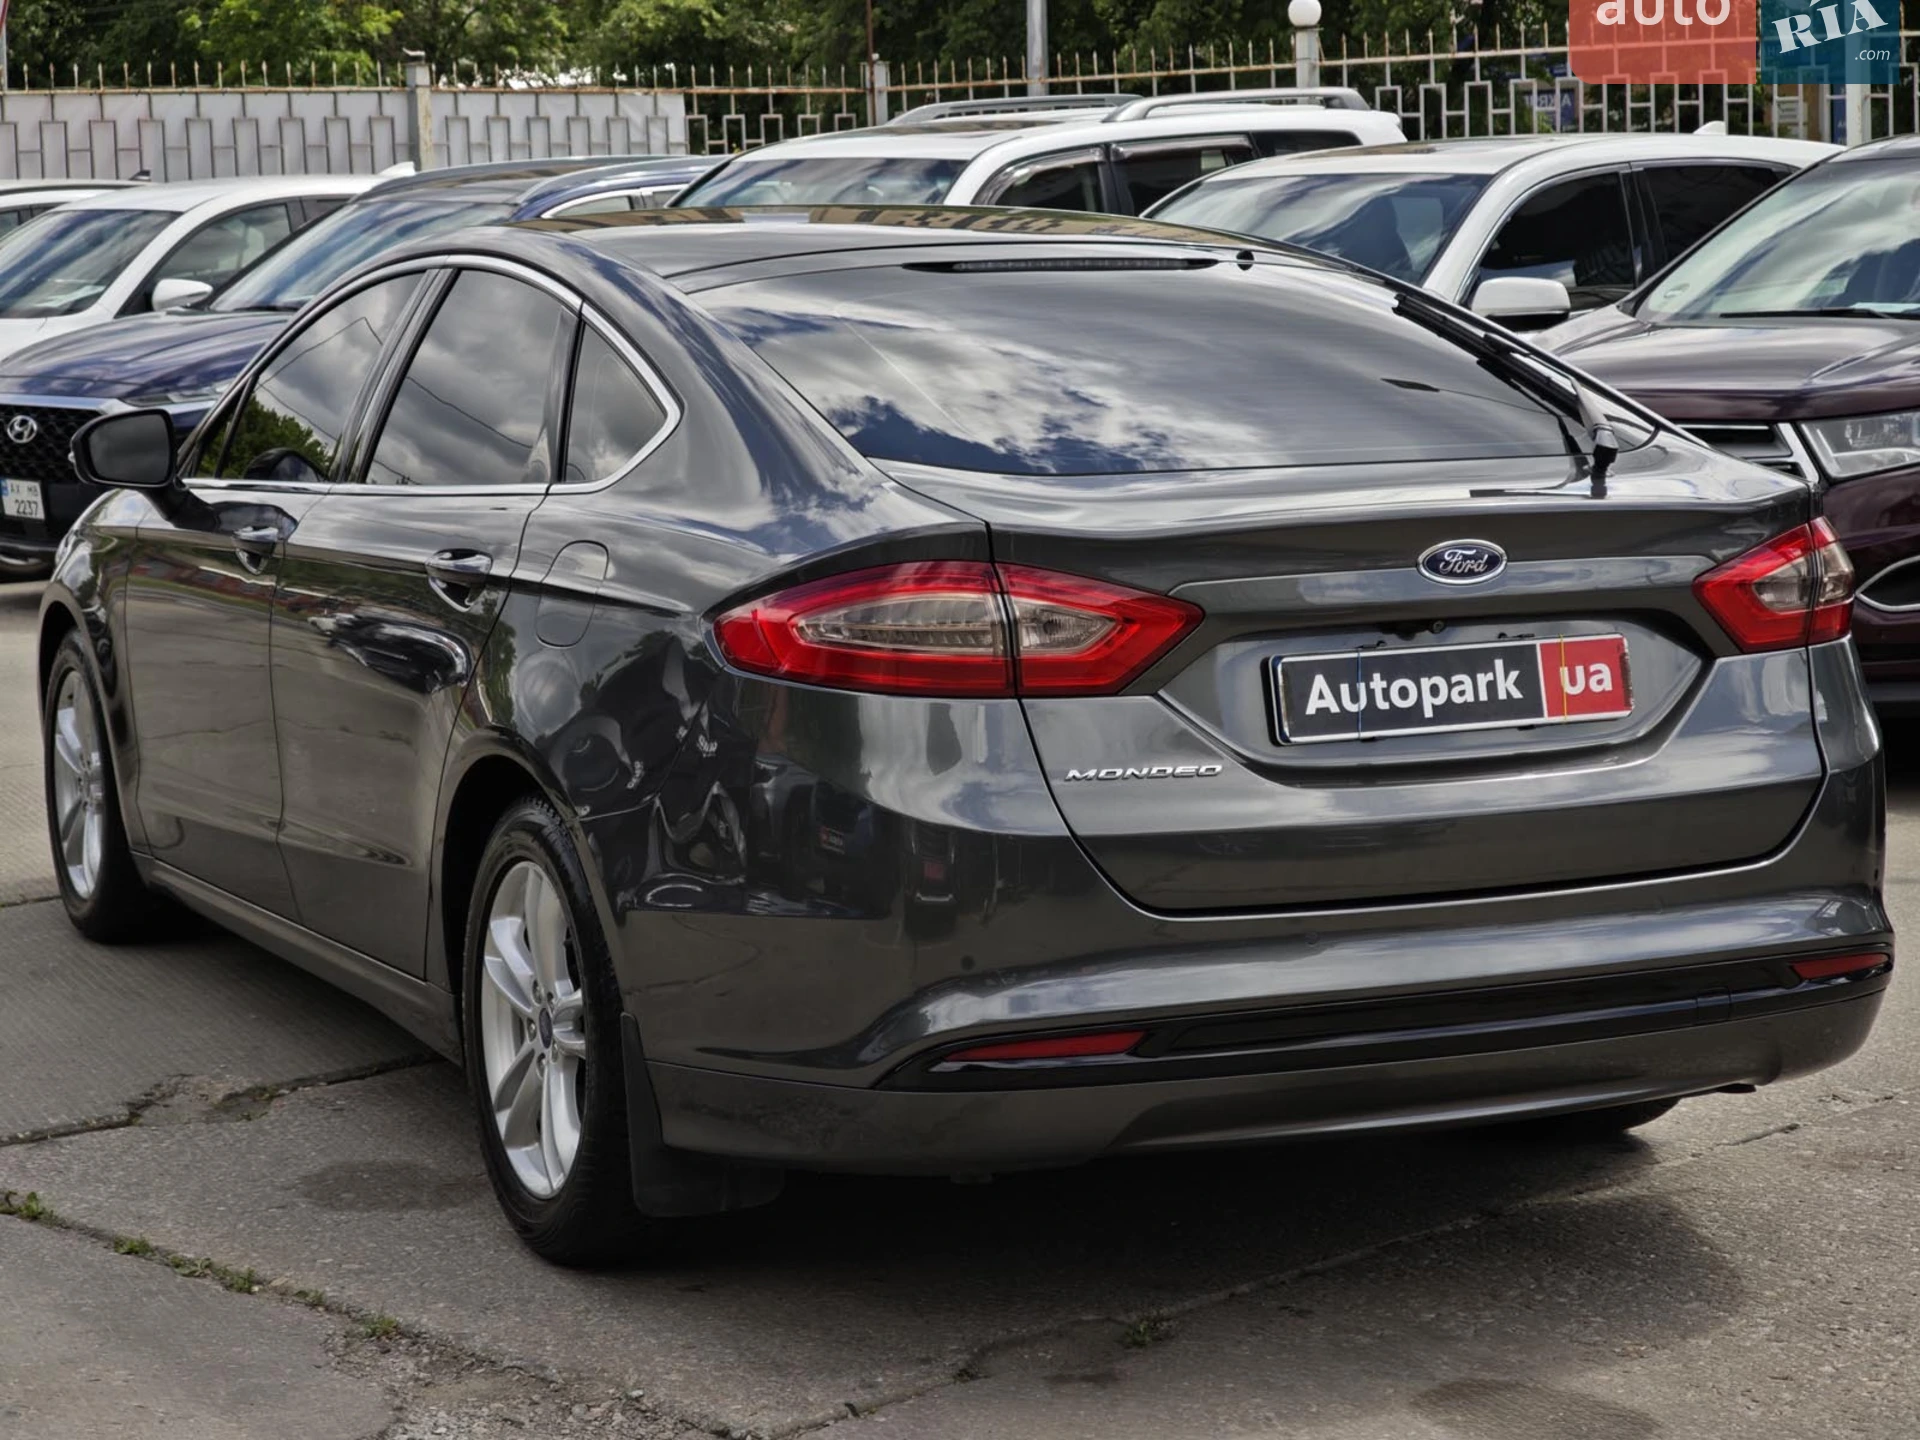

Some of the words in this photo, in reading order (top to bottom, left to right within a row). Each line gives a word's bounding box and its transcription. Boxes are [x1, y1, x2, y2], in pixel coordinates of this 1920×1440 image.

[1439, 549, 1488, 575] Ford
[1305, 659, 1524, 718] Autopark
[1561, 662, 1613, 695] ua
[1065, 764, 1223, 781] MONDEO
